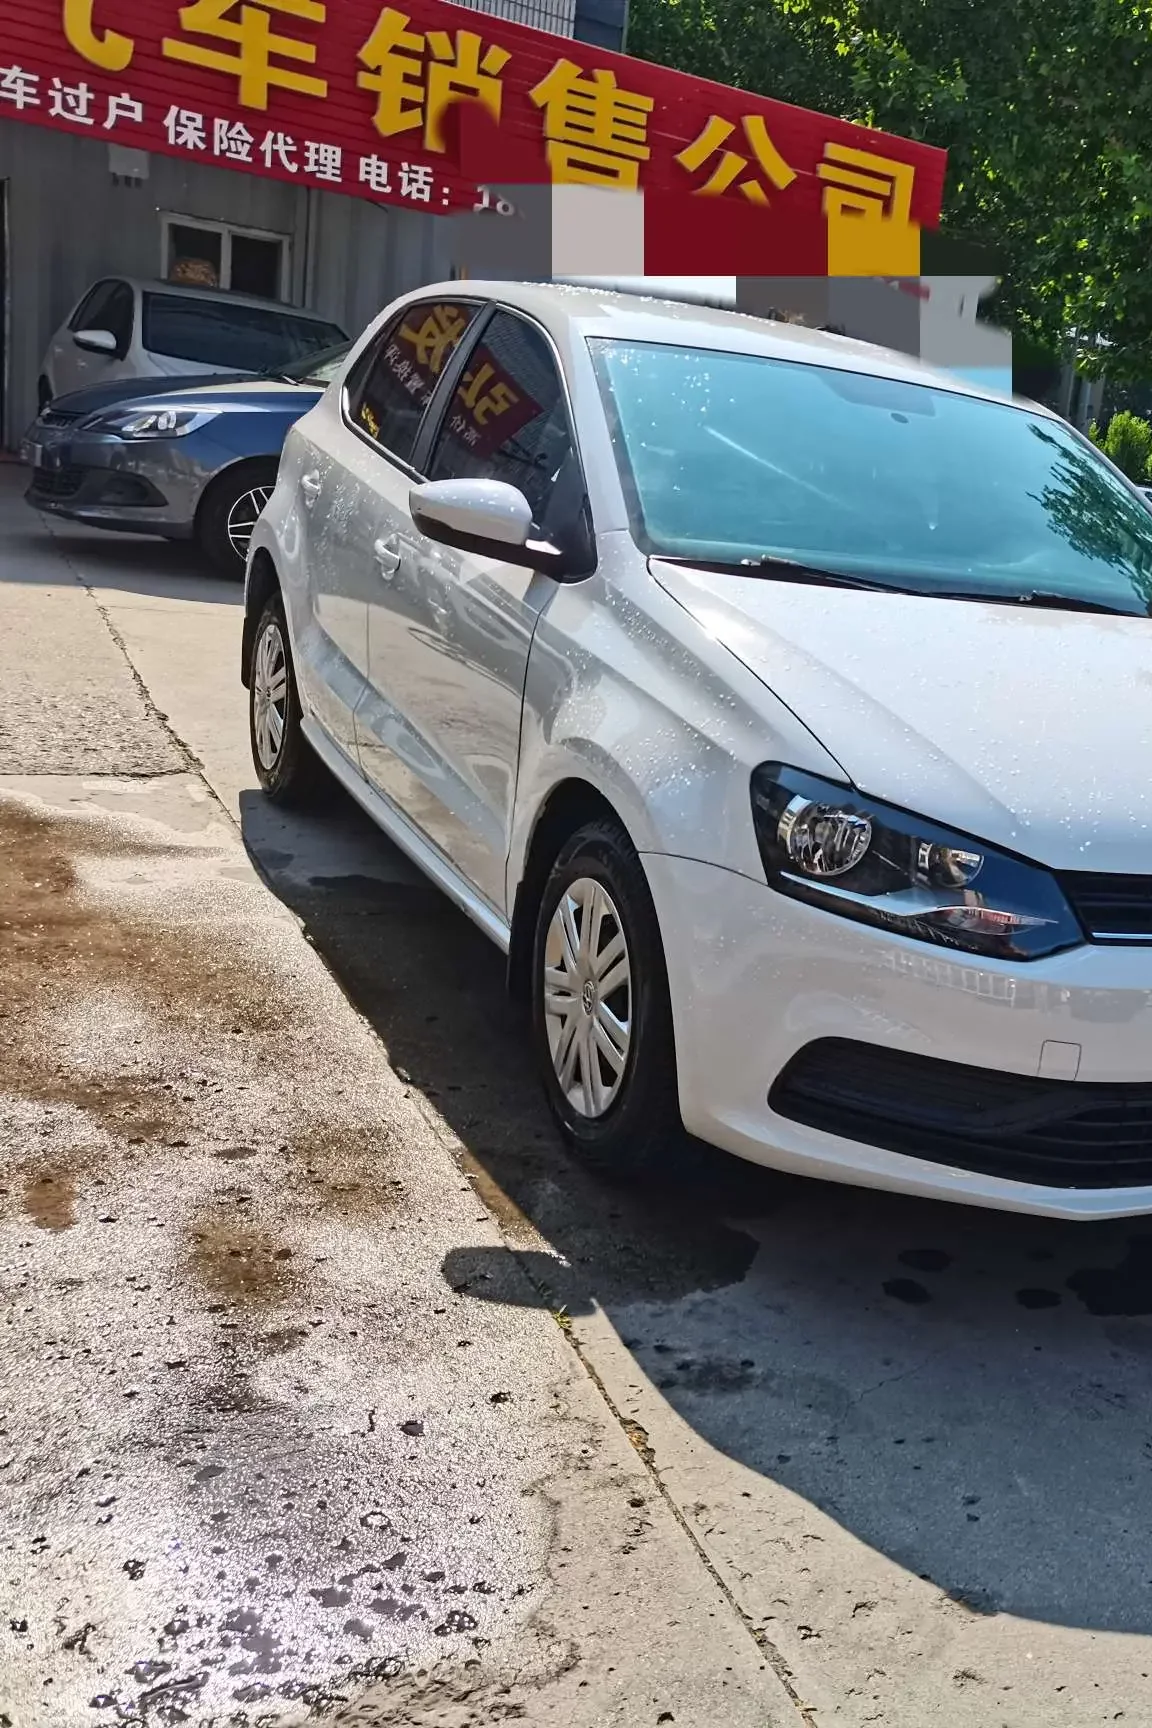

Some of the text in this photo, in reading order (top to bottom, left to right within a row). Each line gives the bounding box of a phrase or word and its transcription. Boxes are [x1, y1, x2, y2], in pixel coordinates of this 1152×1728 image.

[0, 66, 143, 130] 车过户
[162, 105, 343, 184] 保险代理
[62, 0, 921, 226] 车销售公司
